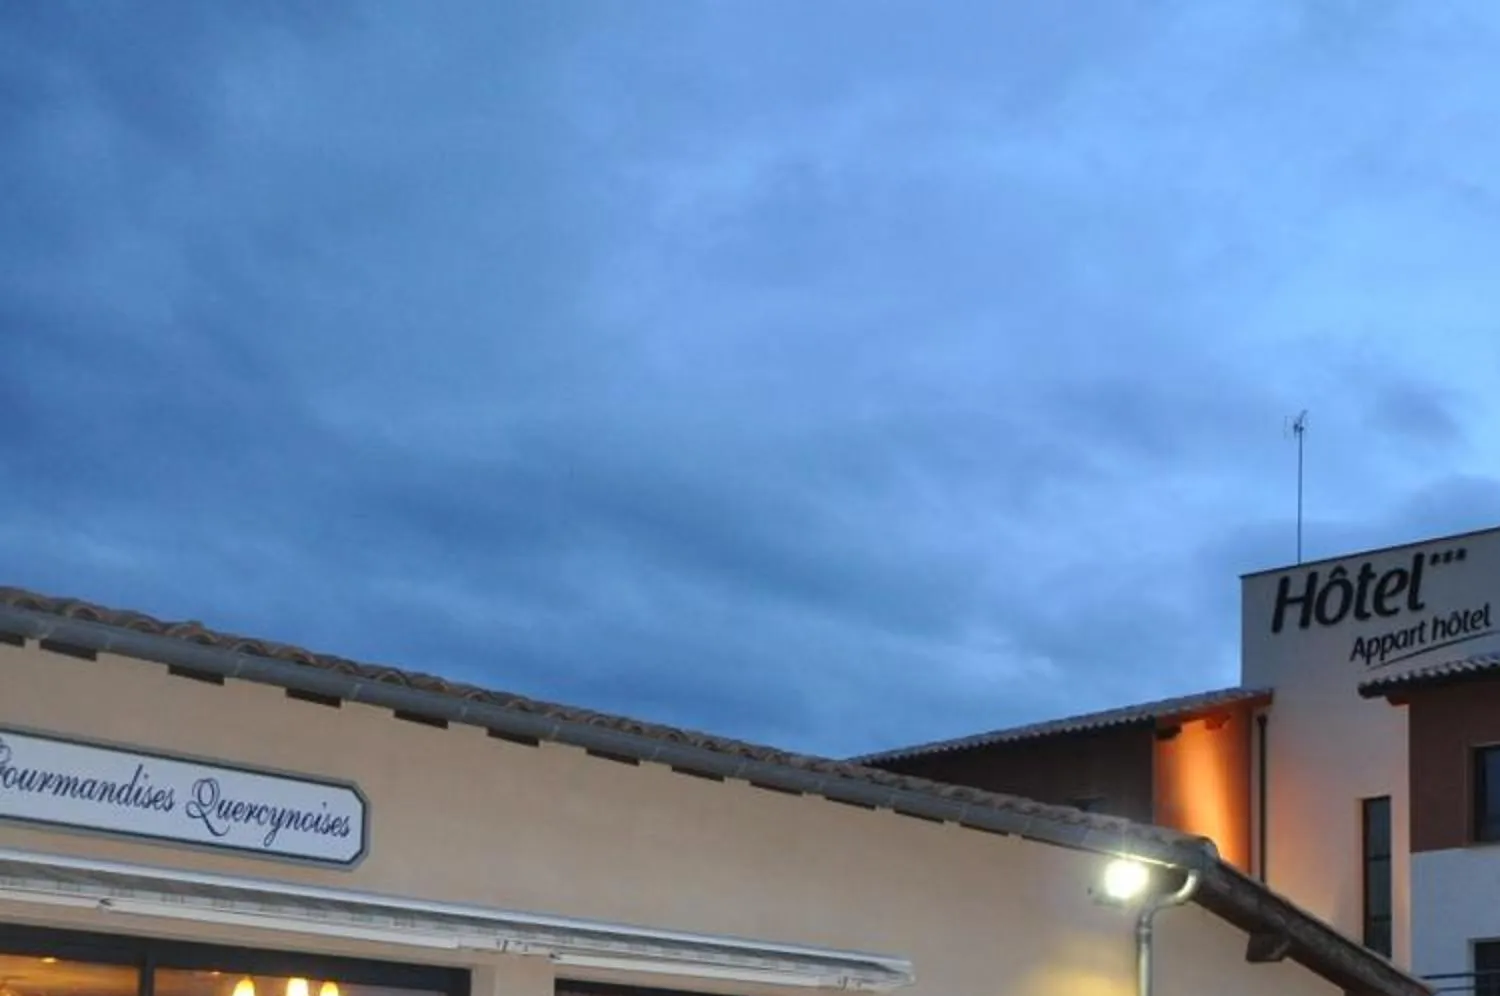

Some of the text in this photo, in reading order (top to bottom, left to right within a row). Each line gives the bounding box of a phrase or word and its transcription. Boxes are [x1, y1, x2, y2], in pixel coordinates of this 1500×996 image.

[1349, 602, 1492, 666] Appart hôtel
[185, 777, 351, 847] Quercynoises
